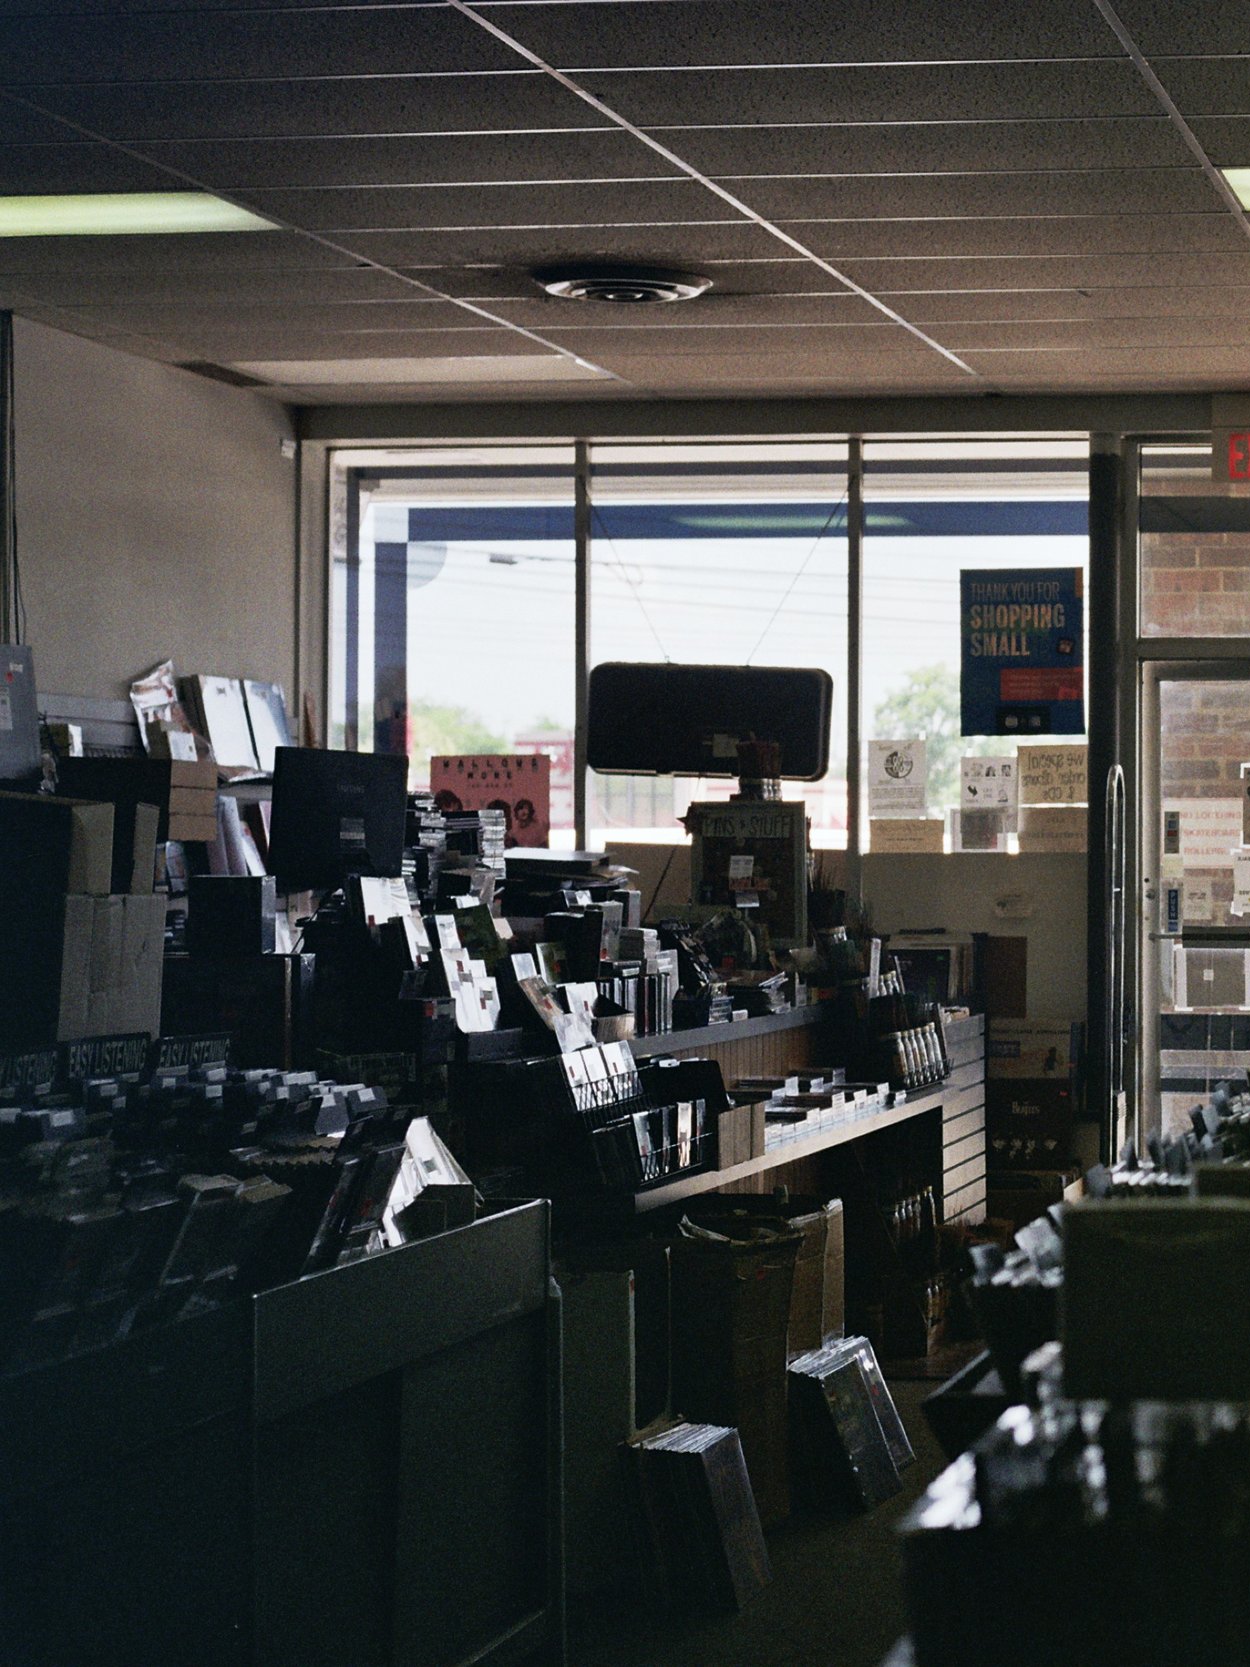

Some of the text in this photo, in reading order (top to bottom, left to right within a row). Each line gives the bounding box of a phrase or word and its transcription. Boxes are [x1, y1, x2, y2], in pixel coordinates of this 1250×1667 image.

[972, 581, 1060, 600] THANK YOU FOR
[970, 603, 1066, 629] SHOPPING
[971, 631, 1030, 656] SMALL
[69, 1038, 147, 1078] EASY LISTENING
